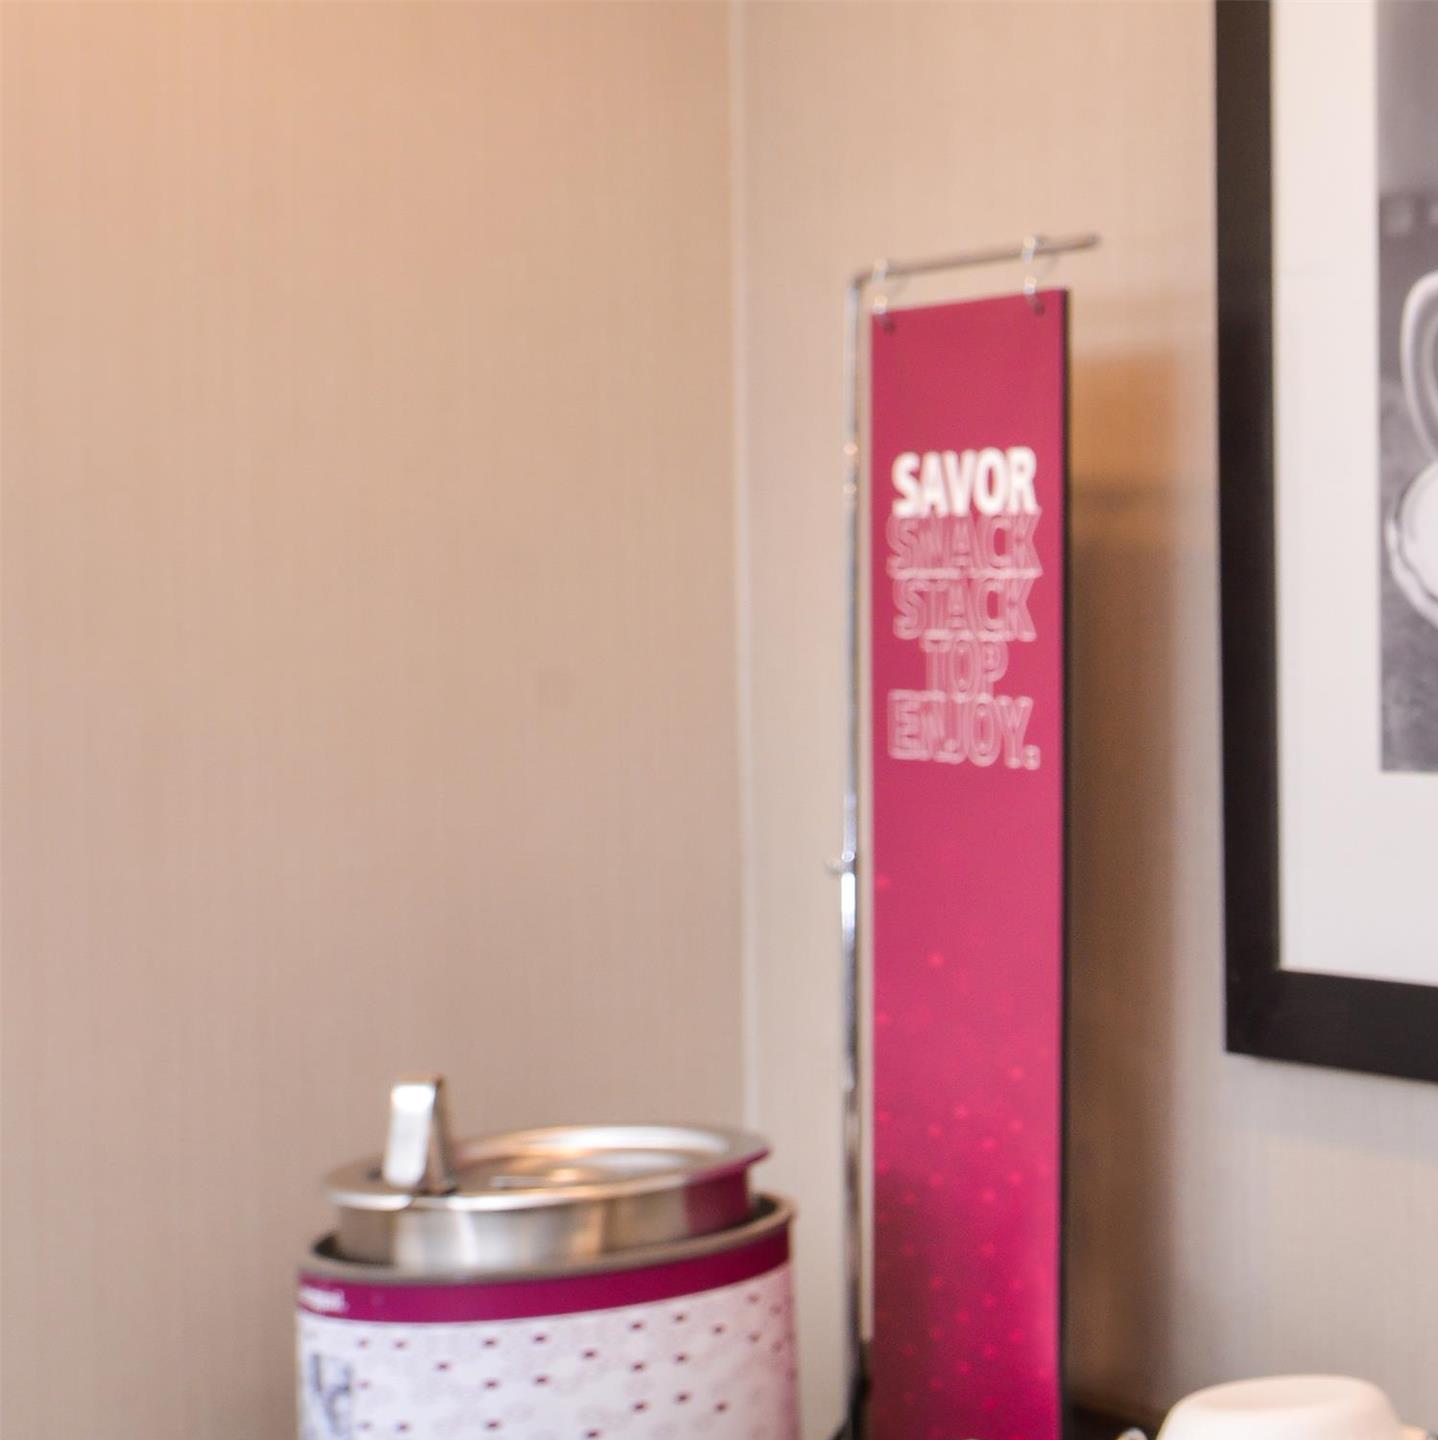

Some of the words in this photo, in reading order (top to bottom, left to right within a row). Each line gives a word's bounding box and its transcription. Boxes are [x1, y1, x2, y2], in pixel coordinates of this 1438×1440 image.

[892, 447, 1038, 518] SAVOR
[893, 573, 1037, 641] STACK
[920, 635, 1008, 701] TOP
[887, 689, 1041, 770] ENJOY.
